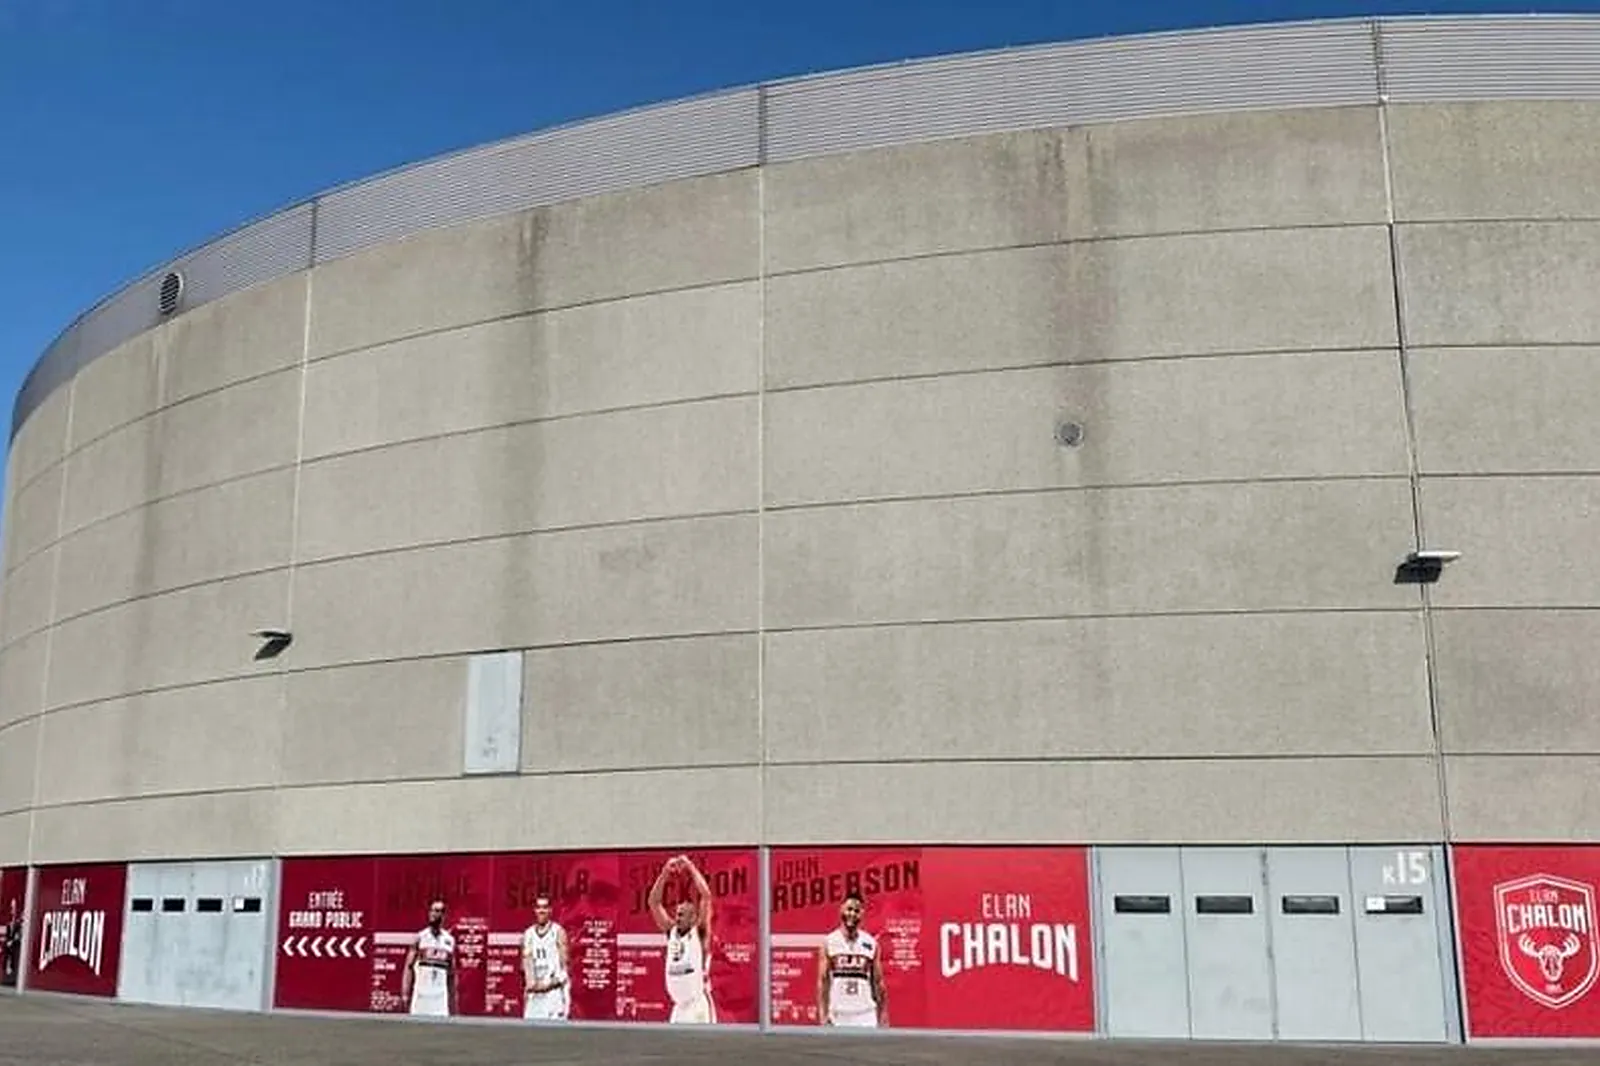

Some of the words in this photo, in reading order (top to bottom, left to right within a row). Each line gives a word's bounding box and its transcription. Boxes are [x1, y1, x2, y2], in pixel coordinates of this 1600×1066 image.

[289, 911, 322, 928] GRAND
[325, 911, 363, 929] PUBLIC
[982, 892, 1031, 919] ELAN
[1506, 903, 1587, 934] CHALON
[39, 910, 105, 976] CHALON
[940, 922, 1079, 982] CHALON
